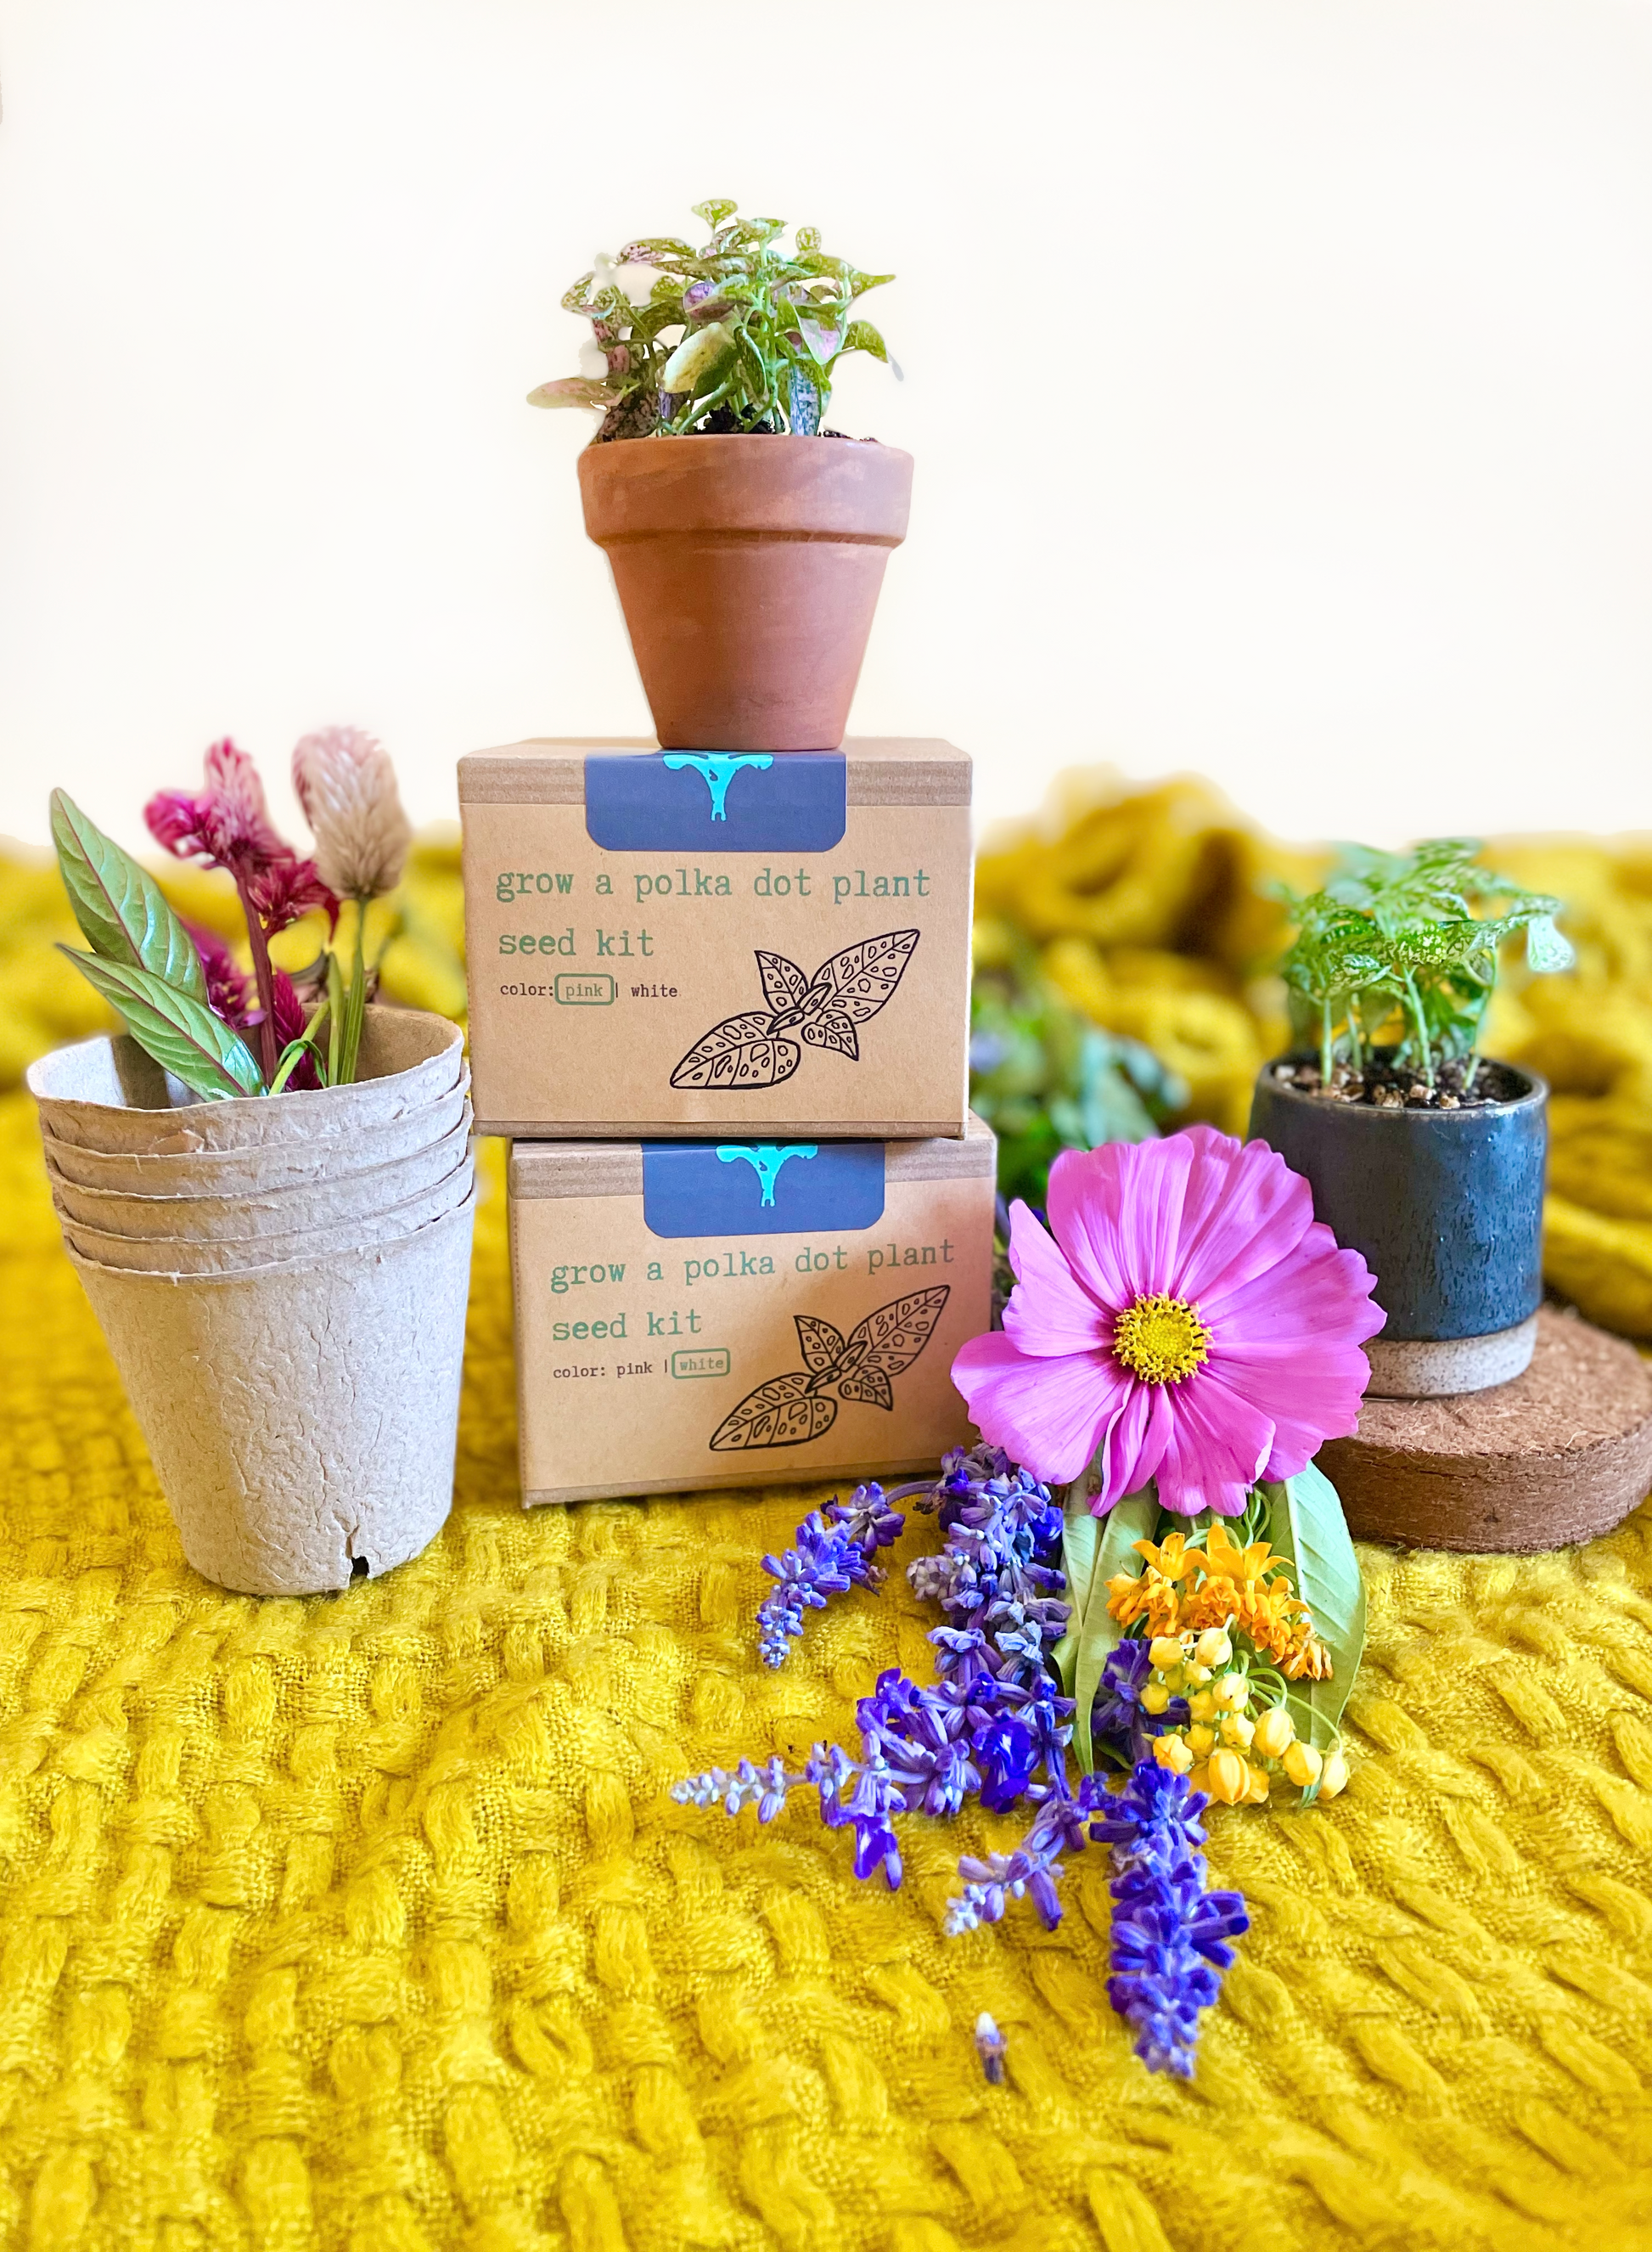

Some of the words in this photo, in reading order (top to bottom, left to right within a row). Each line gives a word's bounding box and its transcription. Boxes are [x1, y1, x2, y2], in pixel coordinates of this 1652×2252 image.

[496, 871, 575, 904] grow
[595, 874, 614, 895] a
[633, 867, 733, 904] polka
[753, 867, 812, 897] dot
[832, 867, 930, 905] plant
[498, 927, 577, 956] seed
[595, 928, 655, 957] kit
[499, 982, 554, 997] color:
[565, 982, 604, 1000] pink
[630, 983, 678, 998] white
[550, 1263, 627, 1295] grow
[647, 1261, 665, 1281] a
[683, 1250, 776, 1286] polka
[795, 1245, 848, 1273] dot
[867, 1238, 954, 1275] plant
[552, 1312, 628, 1342] seed
[646, 1308, 702, 1337] kit
[553, 1365, 606, 1379] color:
[616, 1360, 654, 1379] pink
[679, 1355, 724, 1371] white
